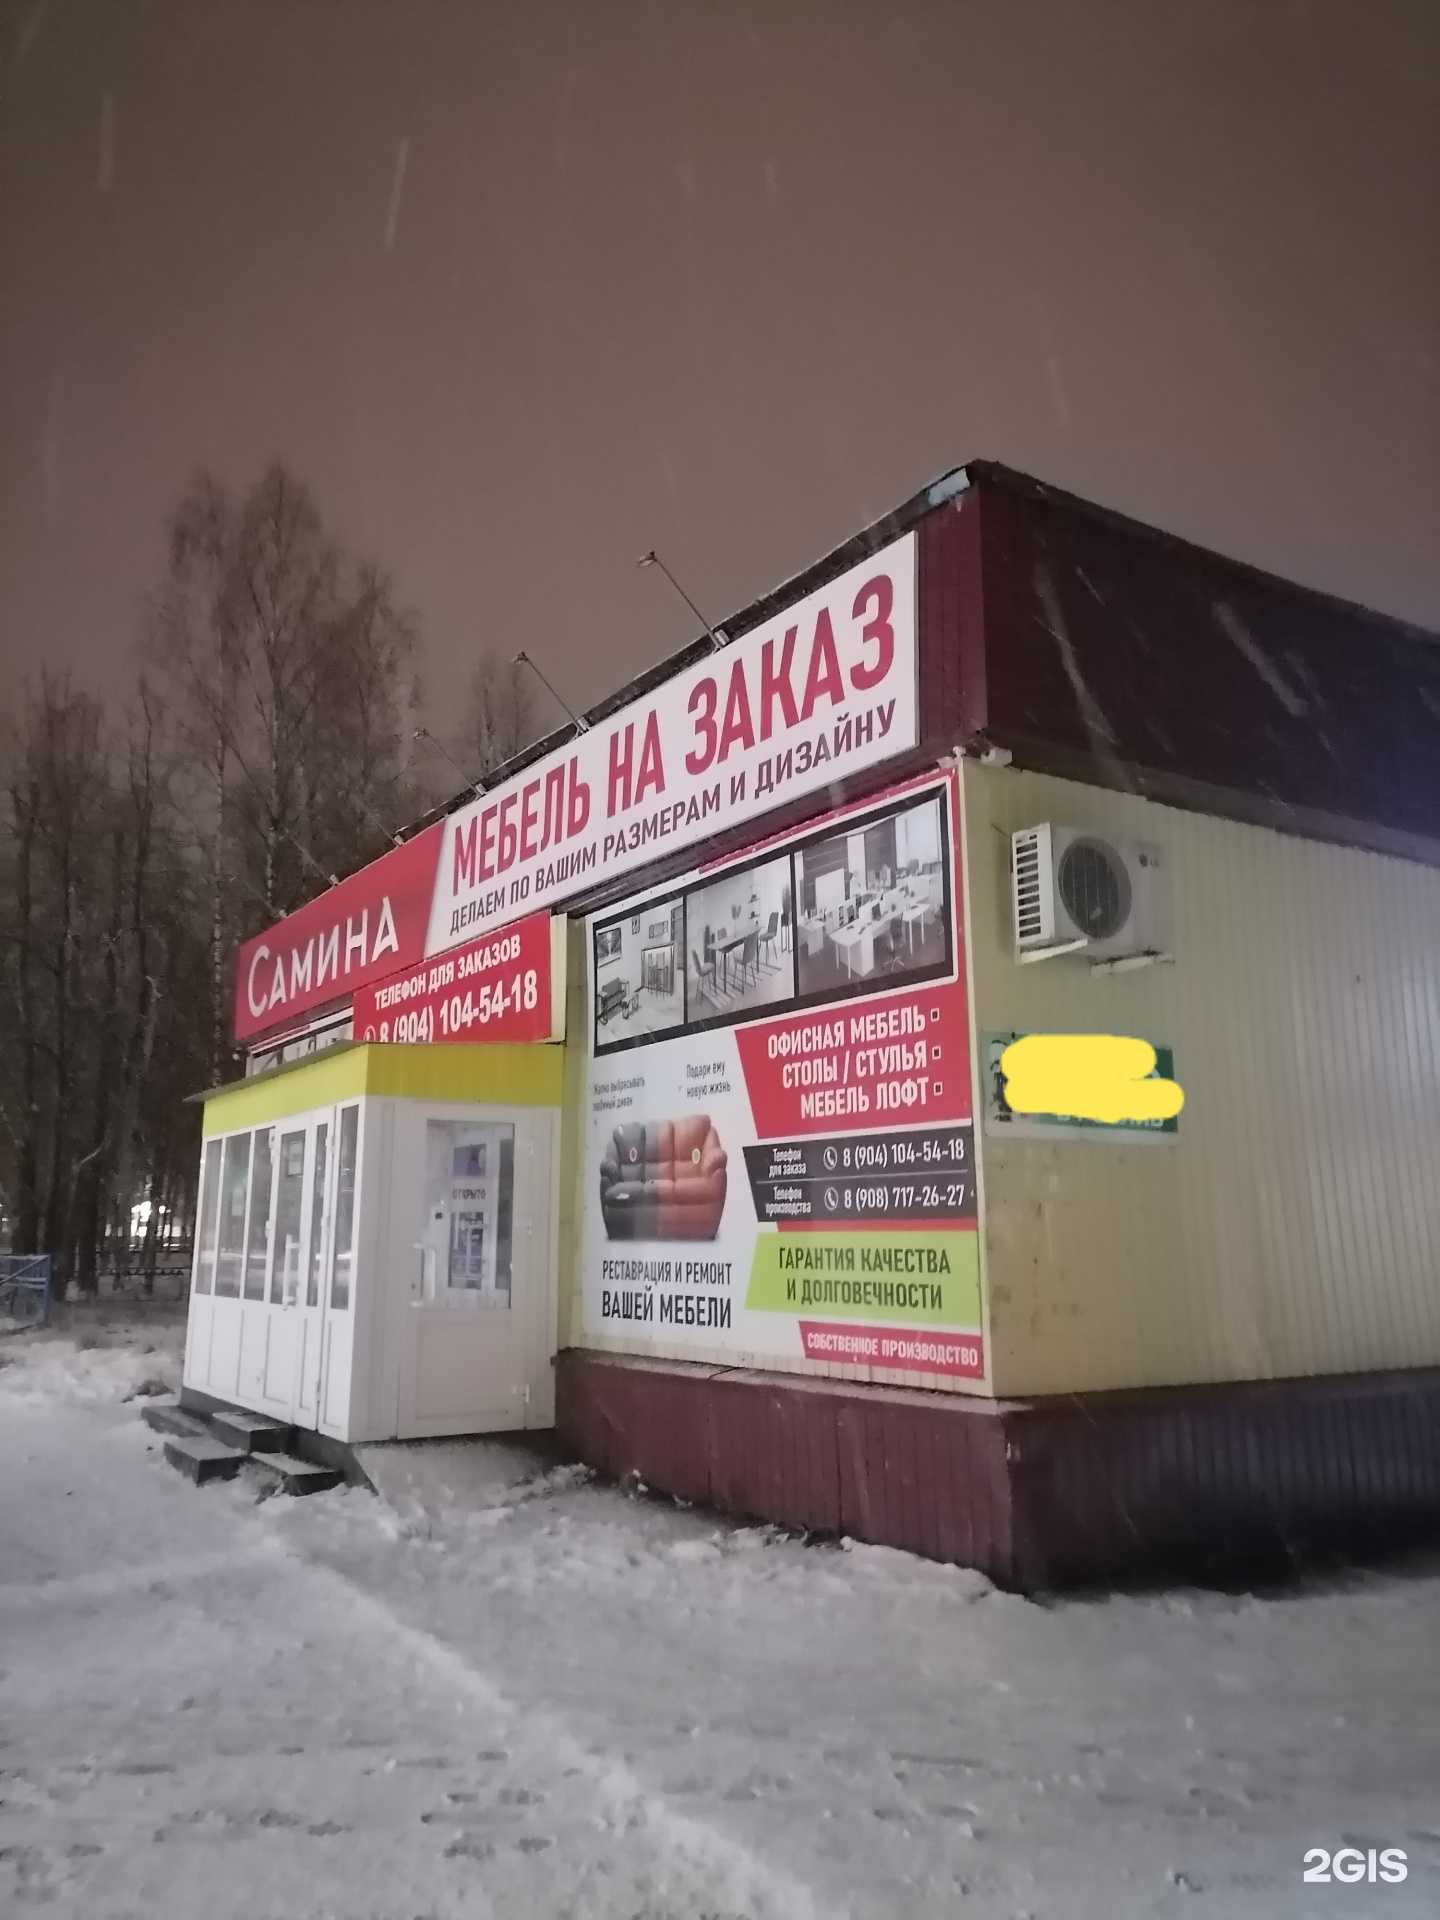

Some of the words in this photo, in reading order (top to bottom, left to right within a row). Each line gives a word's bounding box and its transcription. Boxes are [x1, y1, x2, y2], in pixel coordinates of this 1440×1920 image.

[453, 756, 591, 896] МЕБЕЛЬ
[607, 710, 666, 818] НА
[685, 574, 895, 776] ЗАКАЗ
[450, 894, 505, 936] ДЕЛАЕМ
[510, 880, 530, 905] ПО
[535, 846, 596, 892] ВАШИМ
[603, 782, 721, 864] РАЗМЕРАМ
[730, 776, 746, 805] И
[754, 699, 896, 799] ДИЗАЙНУ
[374, 979, 427, 1011] ТЕЛЕФОН
[429, 960, 455, 990] ДЛЯ
[458, 934, 521, 981] ЗАКАЗОВ
[393, 1005, 433, 1043] (904)
[440, 969, 538, 1035] 104-54-18
[768, 1021, 844, 1059] ОФИСНАЯ
[851, 1006, 926, 1044] МЕБЕЛЬ
[687, 1063, 711, 1079] Подари
[713, 1062, 725, 1076] ему
[782, 1055, 837, 1088] СТОЛЫ
[843, 1051, 850, 1084] /
[856, 1040, 926, 1078] СТУЛЬЯ
[687, 1086, 708, 1100] новую
[709, 1081, 731, 1094] жизнь
[801, 1087, 870, 1119] МЕБЕЛЬ
[876, 1077, 929, 1110] ЛОФТ
[773, 1149, 801, 1163] Телефон
[843, 1149, 851, 1167] 8
[855, 1146, 887, 1169] (904)
[892, 1138, 964, 1163] 104-54-18
[768, 1164, 781, 1178] для
[783, 1162, 807, 1175] заказа
[766, 1201, 811, 1216] производства
[773, 1187, 801, 1201] Телефон
[844, 1190, 851, 1208] 8
[856, 1187, 888, 1212] (908)
[893, 1185, 964, 1208] 717-26-27
[602, 1260, 672, 1284] РЕСТАВРАЦИЯ
[674, 1262, 683, 1282] И
[686, 1262, 732, 1285] РЕМОНТ
[779, 1247, 855, 1272] ГАРАНТИЯ
[861, 1247, 951, 1275] КАЧЕСТВА
[602, 1287, 654, 1323] ВАШЕЙ
[660, 1294, 732, 1329] МЕБЕЛИ
[787, 1278, 797, 1301] И
[801, 1280, 943, 1310] ДОЛГОВЕЧНОСТИ
[807, 1332, 879, 1356] СОБСТВЕННОЕ
[882, 1337, 978, 1366] ПРОИЗВОДСТВО
